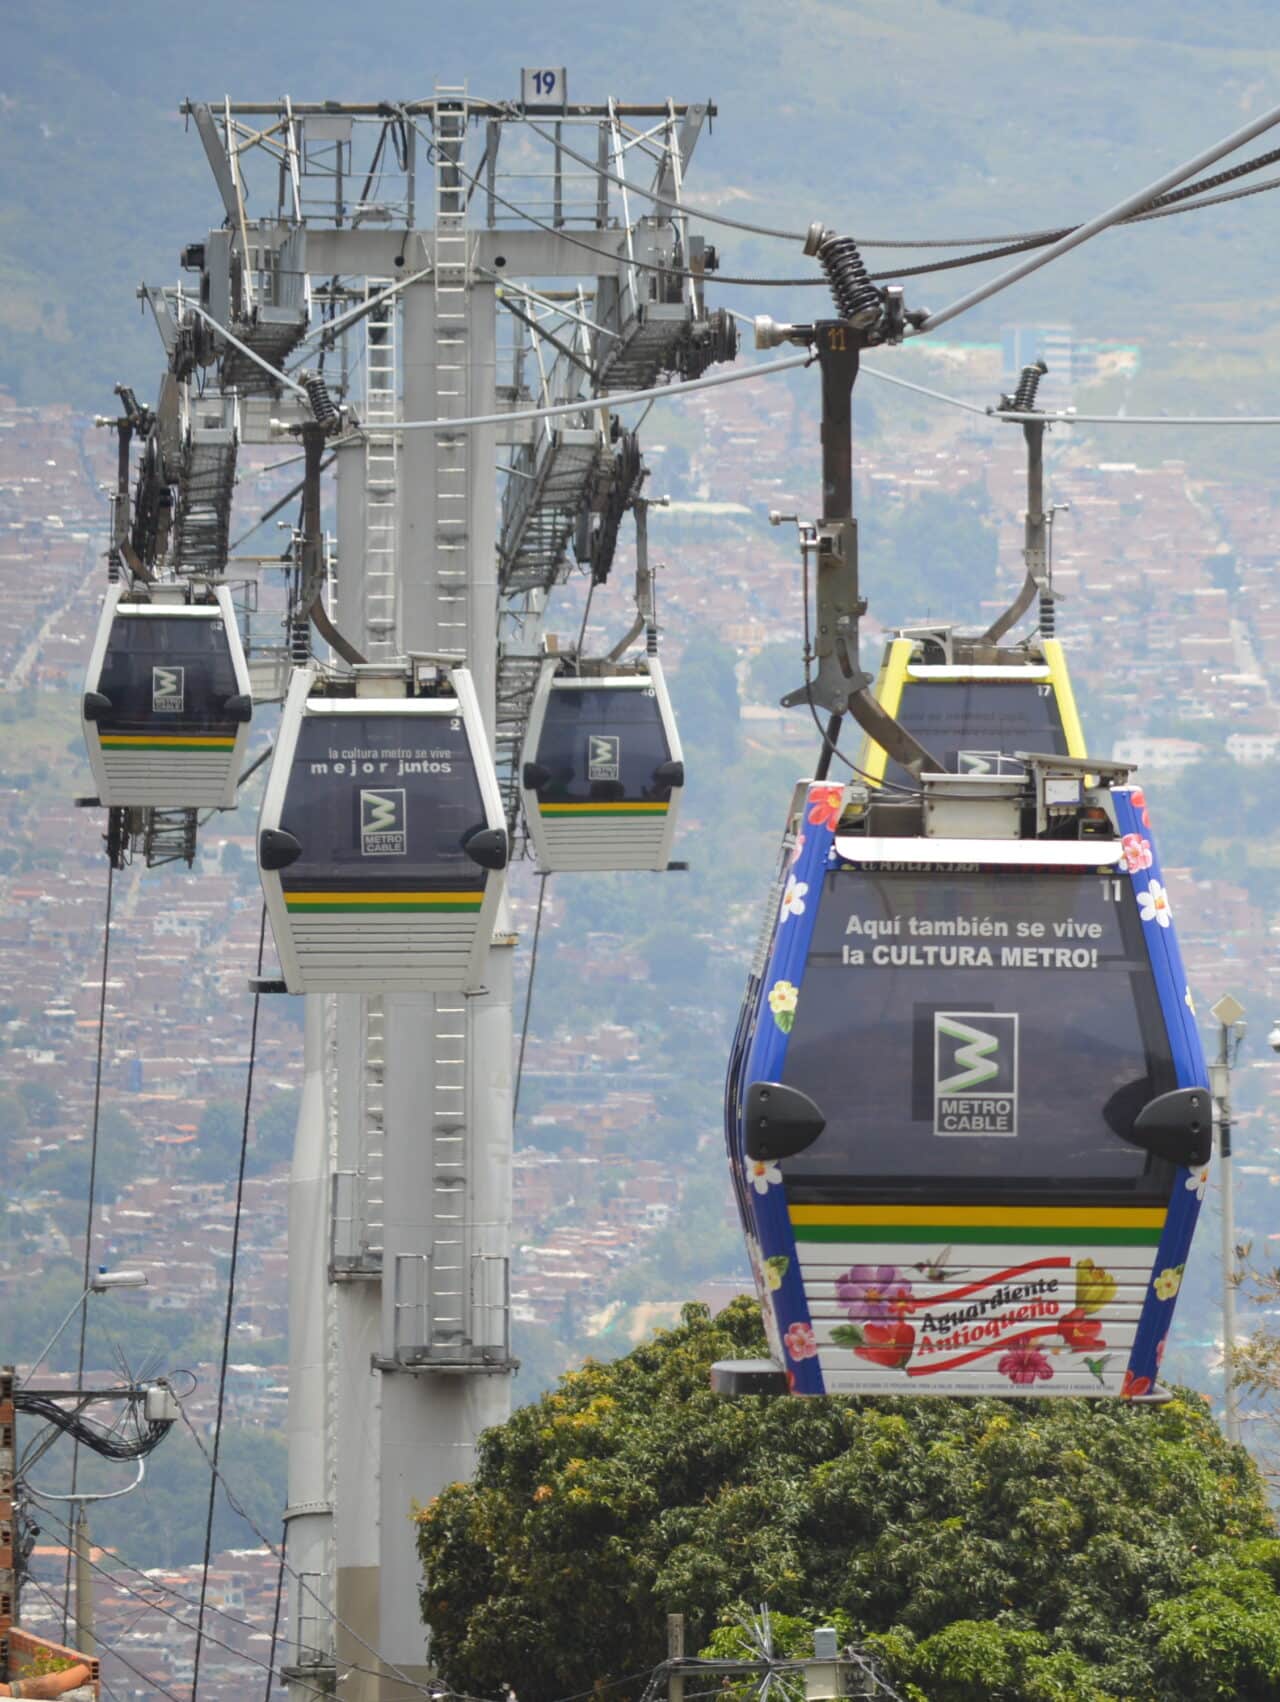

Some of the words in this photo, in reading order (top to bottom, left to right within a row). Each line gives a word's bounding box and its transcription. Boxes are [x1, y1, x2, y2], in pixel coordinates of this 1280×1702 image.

[532, 71, 556, 95] 19
[828, 327, 847, 351] 11
[1037, 685, 1052, 697] 17
[328, 747, 339, 760] la
[341, 747, 379, 760] cultura
[380, 748, 412, 759] metro
[415, 750, 428, 759] se
[398, 760, 452, 776] juntos
[365, 835, 402, 843] METRO
[366, 843, 401, 851] CABLE
[1101, 879, 1122, 902] 11
[908, 915, 1009, 938] también
[1016, 921, 1046, 938] se
[1053, 918, 1102, 938] vive
[842, 945, 864, 965] la
[873, 946, 993, 967] CULTURA
[1001, 947, 1099, 969] METRO!
[941, 1100, 1011, 1115] METRO
[943, 1115, 1008, 1131] CABLE
[920, 1277, 1060, 1334] Aguardiente
[916, 1295, 1060, 1357] Antioqueño
